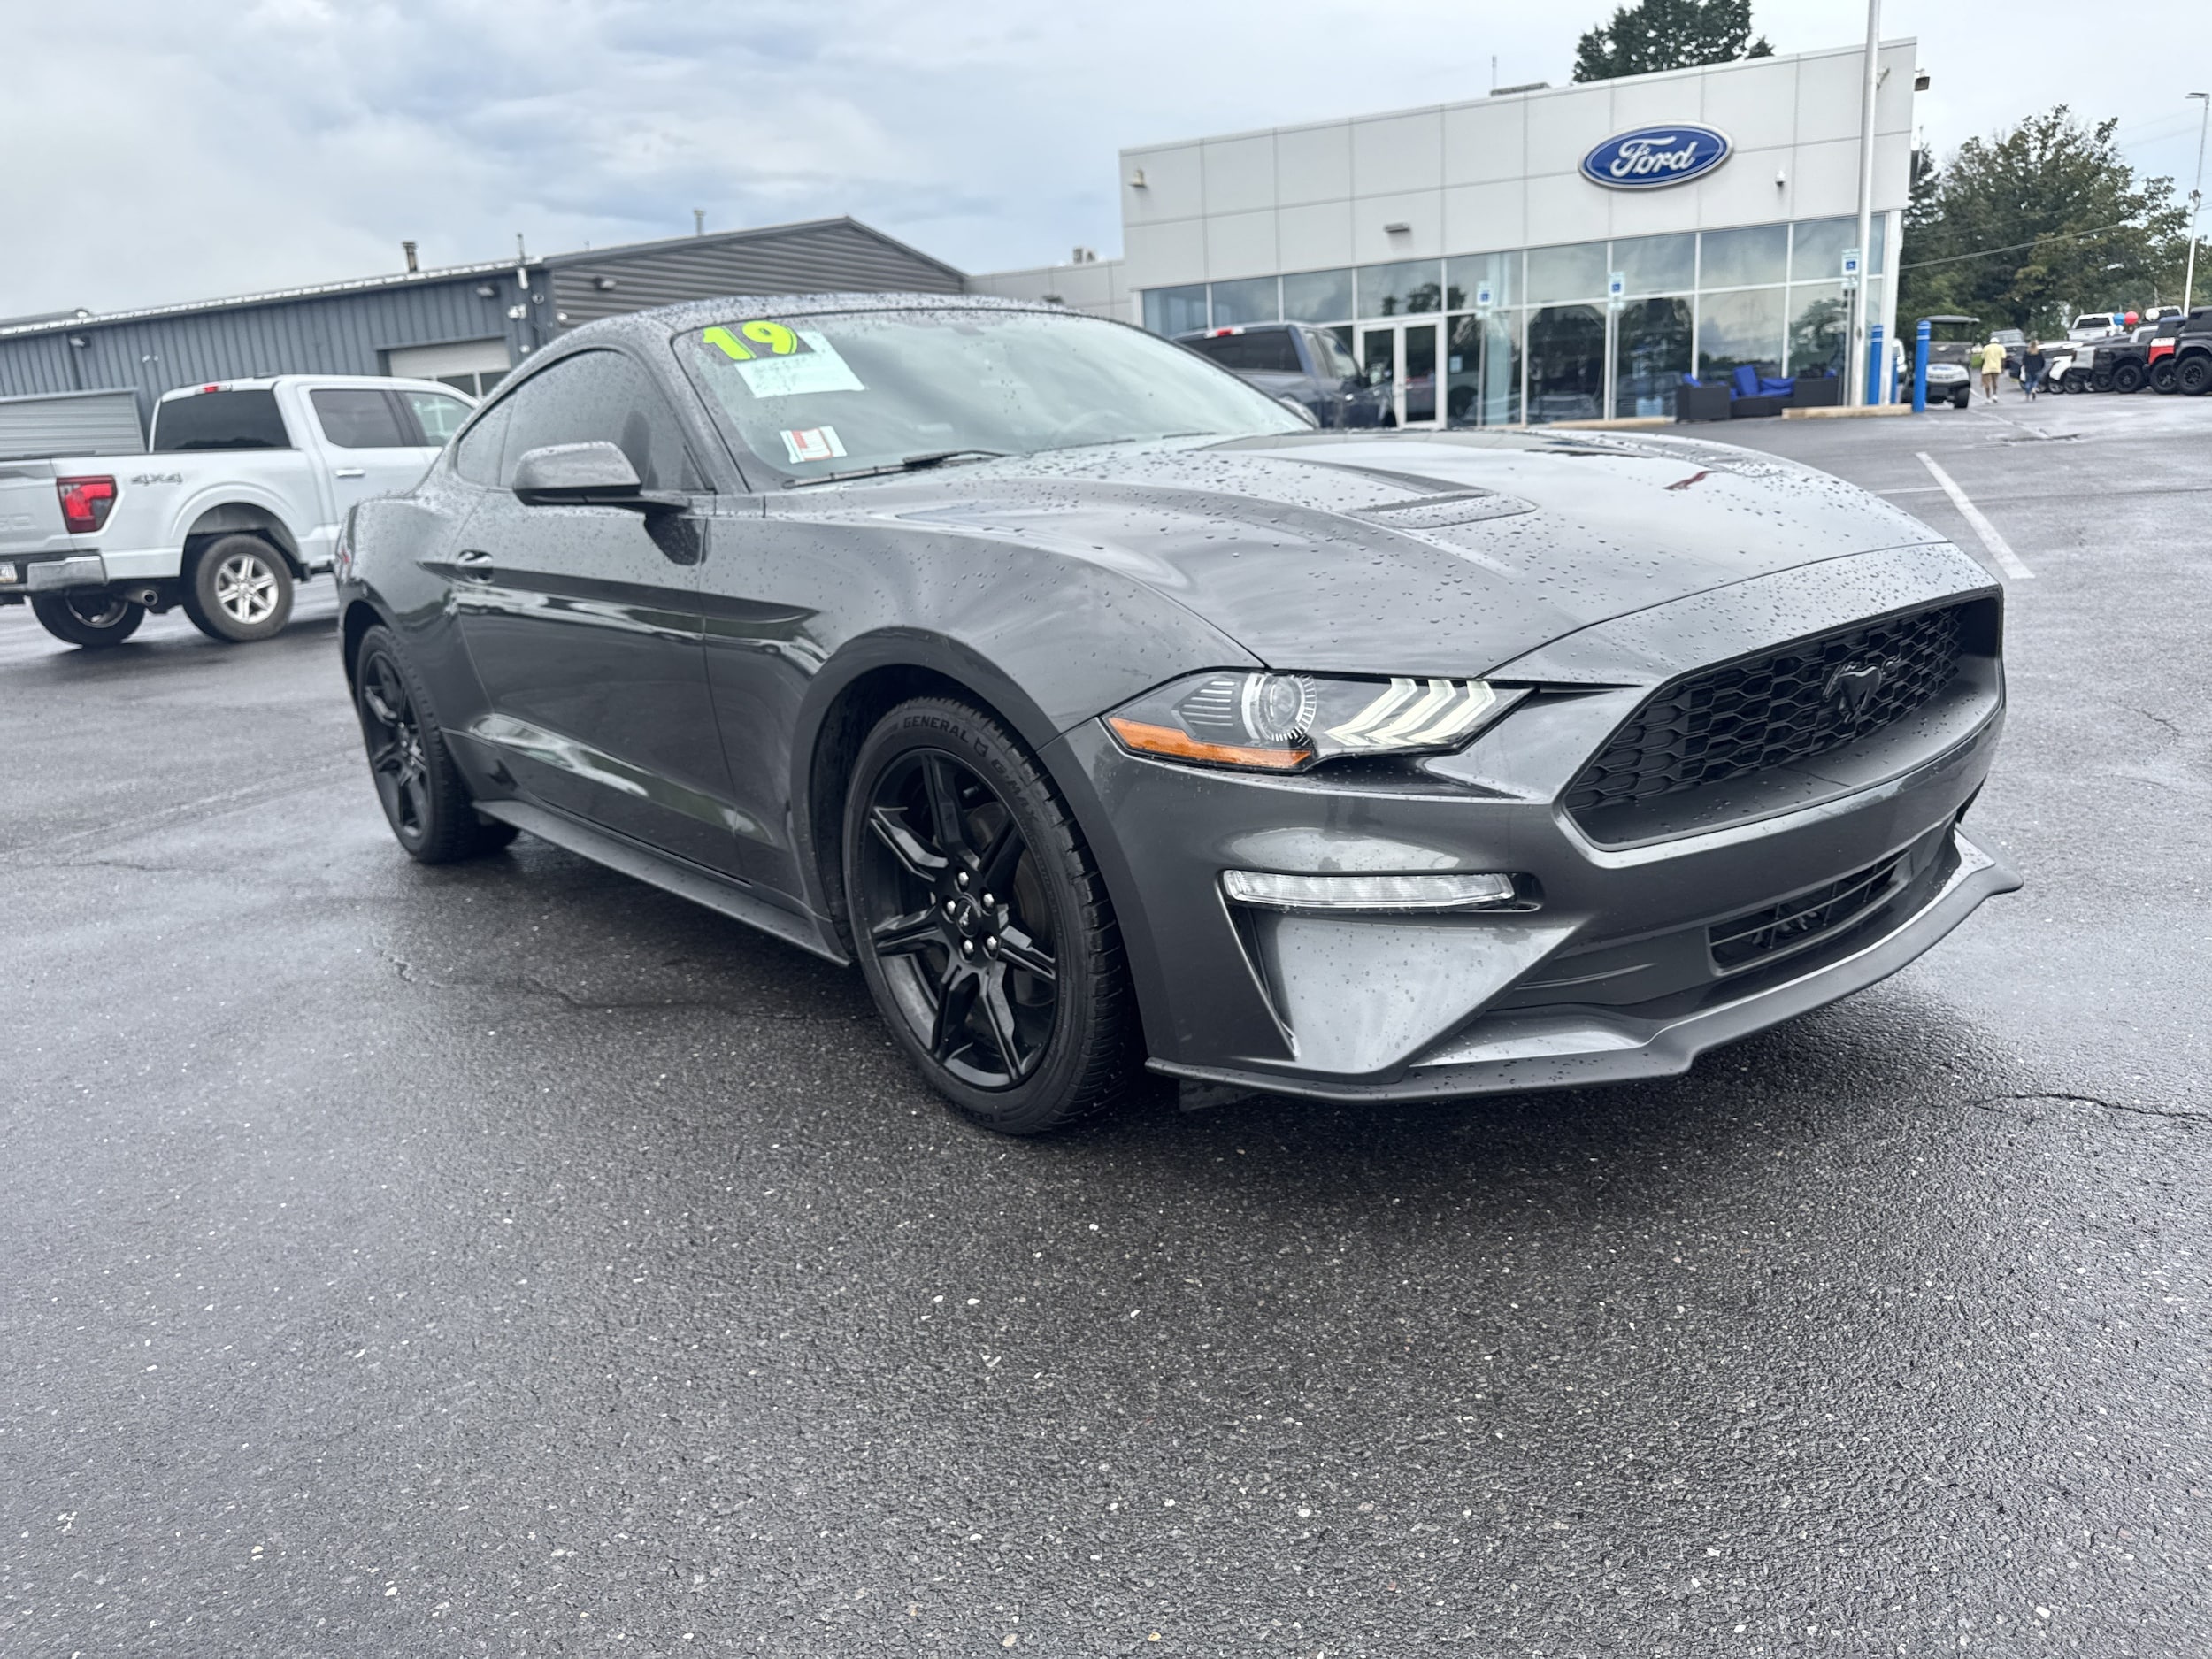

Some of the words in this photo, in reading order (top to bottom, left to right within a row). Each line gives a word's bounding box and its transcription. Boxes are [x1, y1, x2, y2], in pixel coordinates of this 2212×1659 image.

[1609, 135, 1699, 178] Ford
[703, 320, 798, 361] 19
[902, 714, 970, 744] GENERAL
